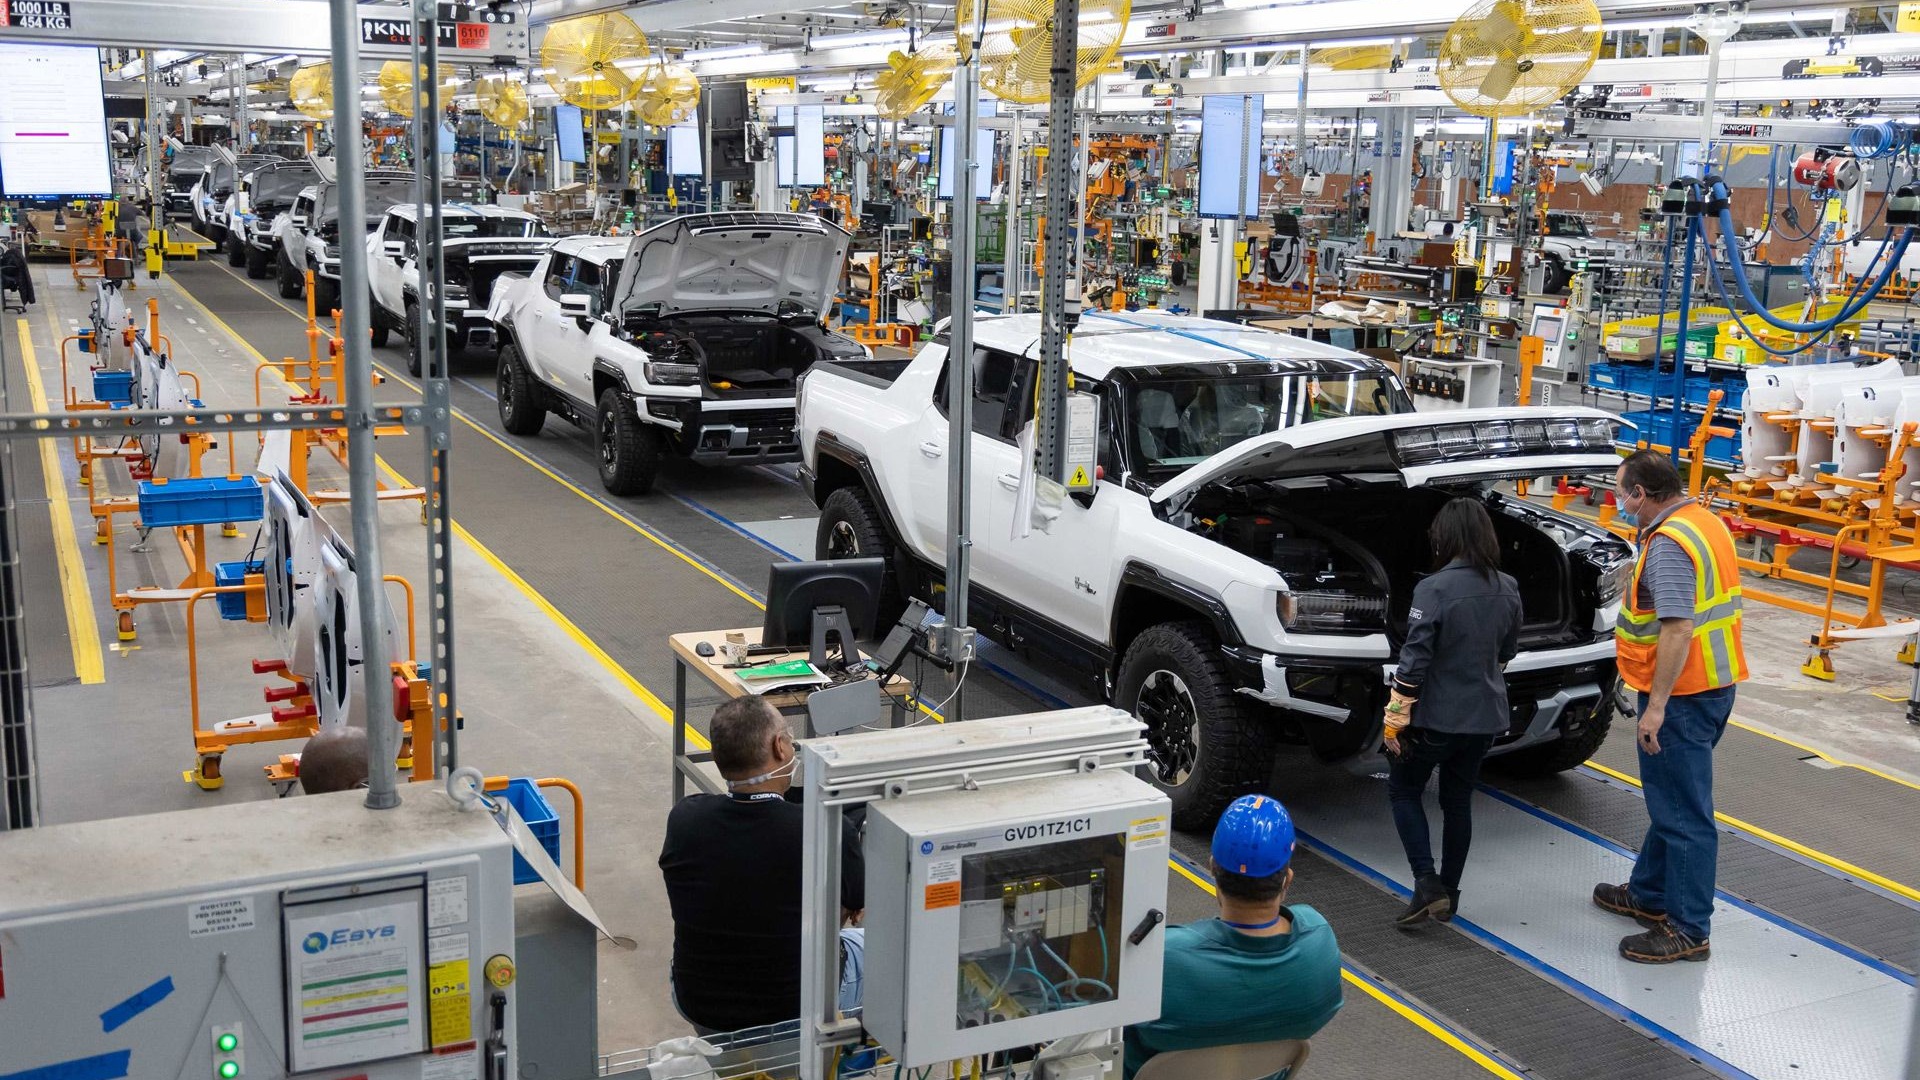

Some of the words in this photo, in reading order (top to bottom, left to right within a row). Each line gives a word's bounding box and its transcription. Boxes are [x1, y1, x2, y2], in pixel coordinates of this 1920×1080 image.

[11, 1, 41, 14] 1000
[45, 2, 67, 15] LB.
[20, 16, 42, 28] 454
[46, 17, 70, 29] KG.
[374, 22, 454, 39] KNIT
[461, 27, 485, 38] 6110
[1724, 124, 1752, 132] KNIGHT
[1004, 819, 1091, 842] GVD1TZ1C1
[940, 841, 977, 851] Allen-Bradley
[211, 909, 232, 917] FROM
